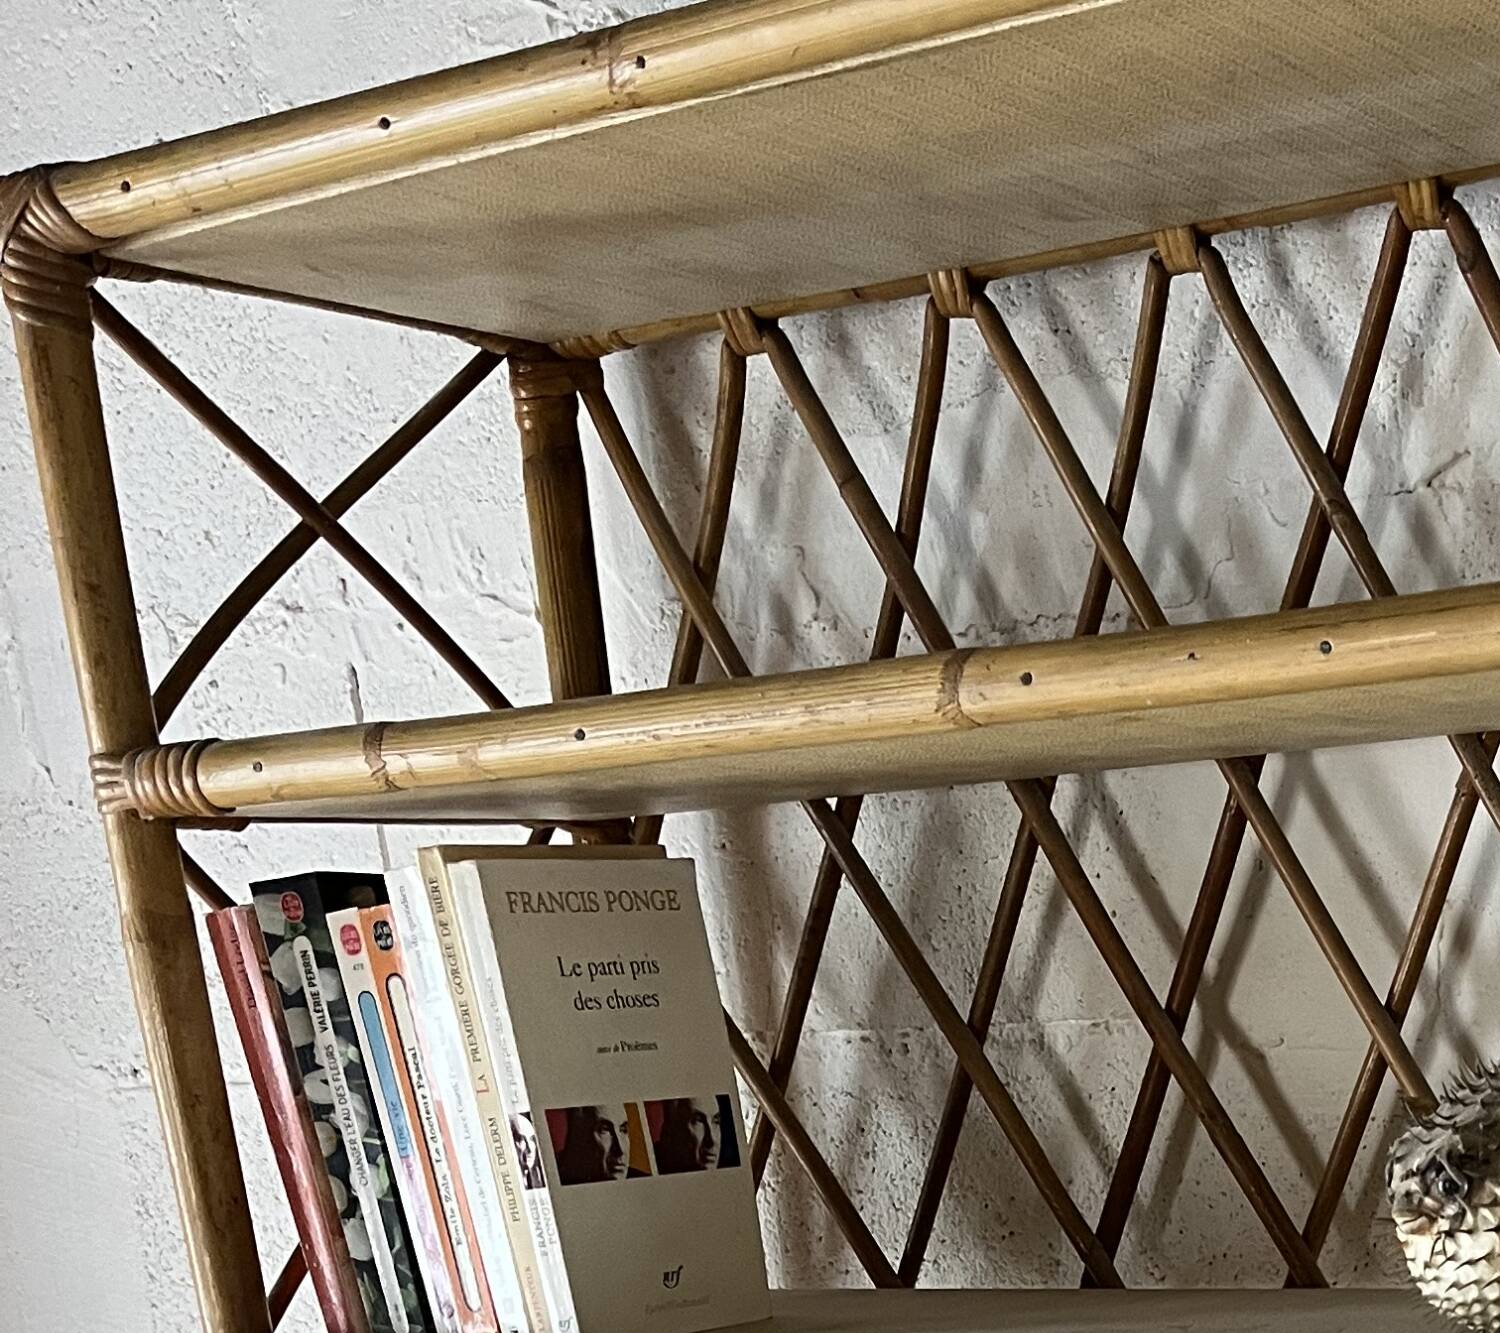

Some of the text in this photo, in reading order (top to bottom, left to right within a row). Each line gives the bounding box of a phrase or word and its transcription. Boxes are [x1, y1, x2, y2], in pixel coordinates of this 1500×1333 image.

[505, 889, 681, 913] FRANCIS PONGE
[439, 920, 451, 937] DE
[557, 952, 661, 982] Le parti pris
[574, 989, 660, 1011] des choses
[300, 950, 368, 1186] CHANGER L'EAU DES FLEURS VALÉRIE PERRIN
[408, 1047, 424, 1089] Pascal
[421, 1094, 437, 1143] docteur
[435, 1148, 442, 1163] Le
[488, 1117, 520, 1222] PHILIPPE DELERM
[442, 1174, 452, 1202] Zola
[531, 1198, 548, 1256] FRANCIS
[539, 1197, 557, 1245] PONGE
